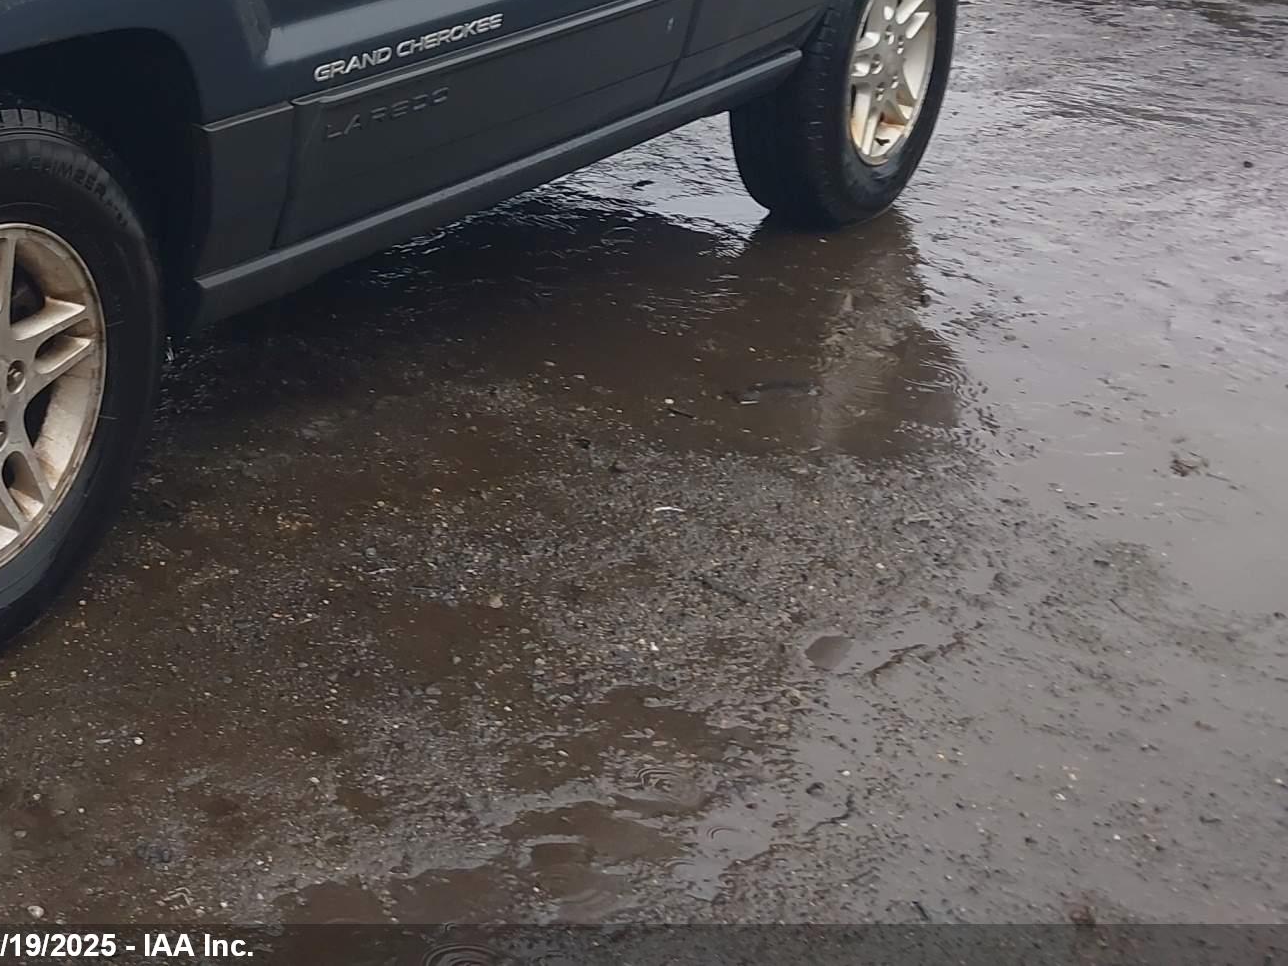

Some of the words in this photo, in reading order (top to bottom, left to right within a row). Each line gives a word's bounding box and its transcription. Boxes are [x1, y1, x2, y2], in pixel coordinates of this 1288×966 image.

[313, 46, 393, 83] GRAND
[395, 12, 505, 59] CHEROKEE
[326, 86, 450, 140] LAREDO
